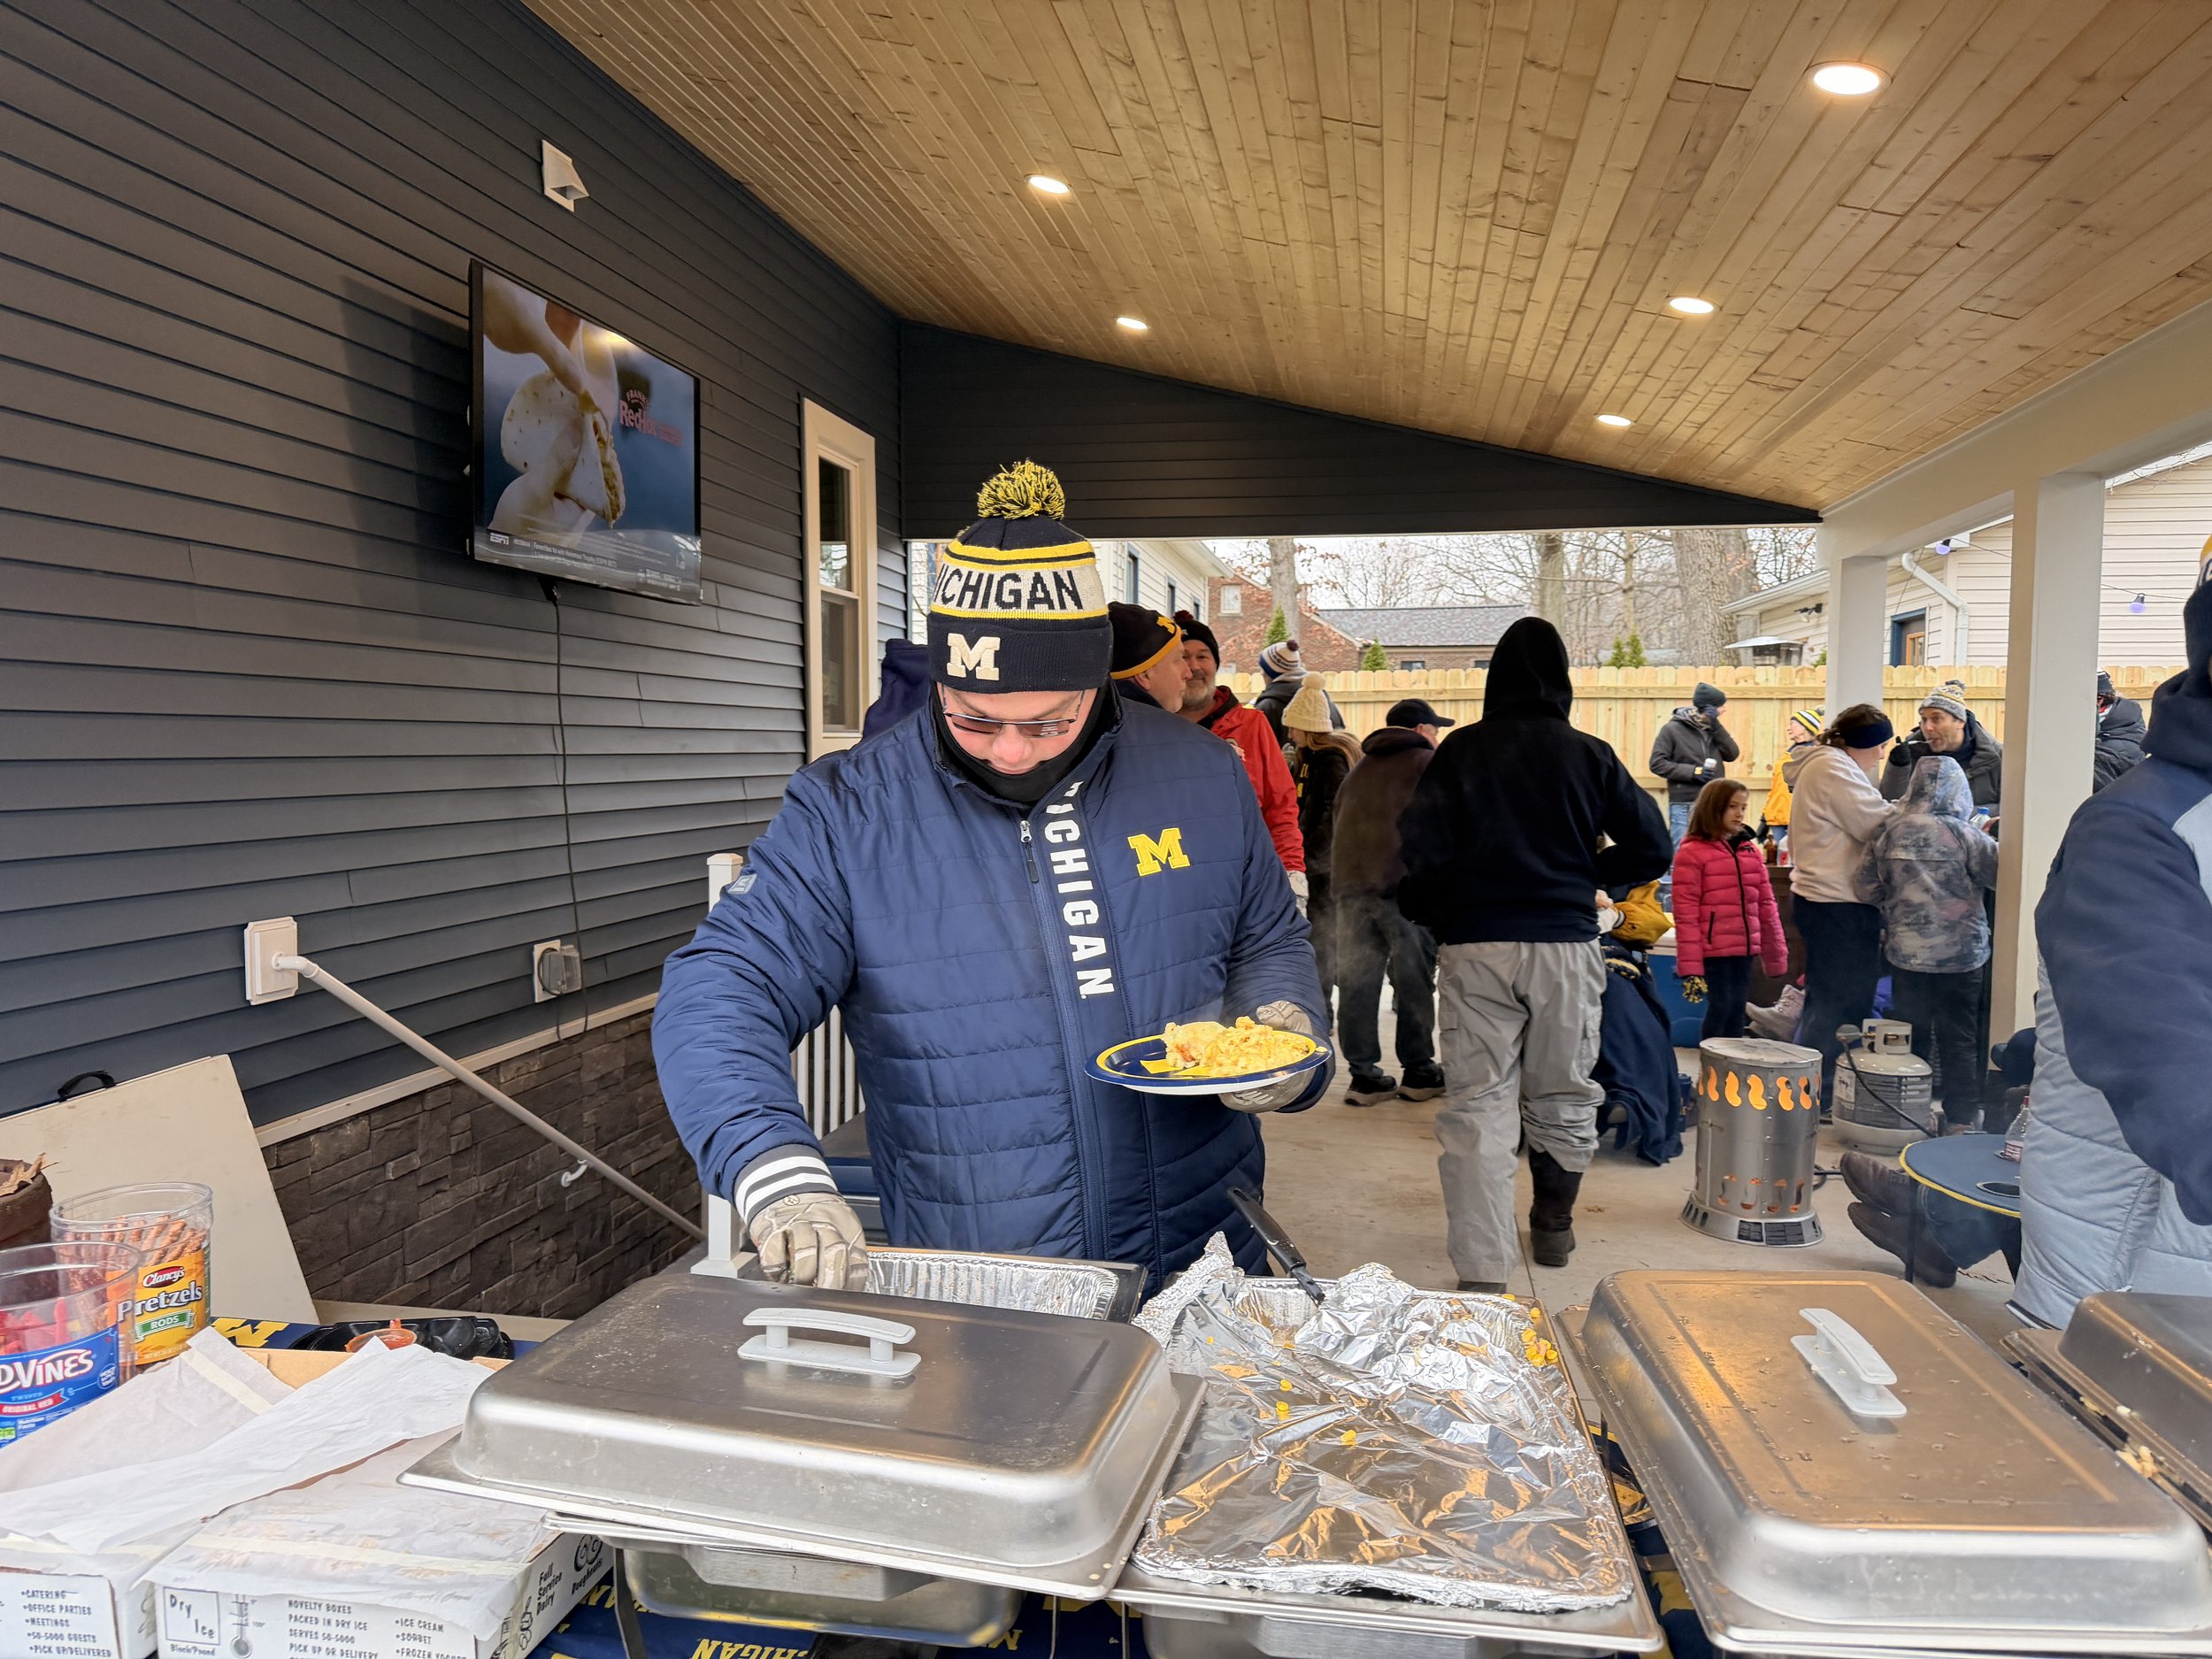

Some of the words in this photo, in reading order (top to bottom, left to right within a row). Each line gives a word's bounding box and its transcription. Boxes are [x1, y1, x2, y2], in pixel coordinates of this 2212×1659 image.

[489, 532, 510, 545] ESPN
[933, 564, 1083, 611] ICHIGAN
[947, 633, 1001, 680] M
[1127, 827, 1190, 877] M
[143, 1267, 185, 1288] Clancy's
[117, 1280, 204, 1323] Pretzels
[150, 1316, 180, 1330] RODS
[540, 1562, 554, 1586] Full
[538, 1571, 563, 1601] Service
[26, 1590, 66, 1600] CATERING
[28, 1604, 56, 1614] OFFICE
[59, 1606, 92, 1616] PARTIES
[169, 1594, 192, 1618] Dry
[288, 1600, 322, 1612] NOVELTY
[326, 1603, 351, 1615] BOXES
[536, 1591, 556, 1616] Dairy
[30, 1618, 70, 1628] MEETINGS
[194, 1618, 215, 1640] Ice
[288, 1614, 319, 1625] PACKED
[322, 1617, 332, 1627] IN
[335, 1618, 351, 1630] DRY
[354, 1621, 368, 1631] ICE
[400, 1618, 414, 1628] ICE
[418, 1620, 444, 1632] CREAM
[32, 1632, 65, 1641] 50-5000
[67, 1633, 96, 1643] GUESTS
[288, 1628, 319, 1640] SERVES
[321, 1632, 355, 1644] 50-5000
[401, 1632, 432, 1645] SORBET
[34, 1645, 52, 1655] PICK
[289, 1643, 309, 1654] PICK
[311, 1645, 322, 1655] UP
[326, 1647, 336, 1656] OR
[340, 1648, 379, 1659] DELIVERY
[401, 1647, 432, 1659] FROZEN
